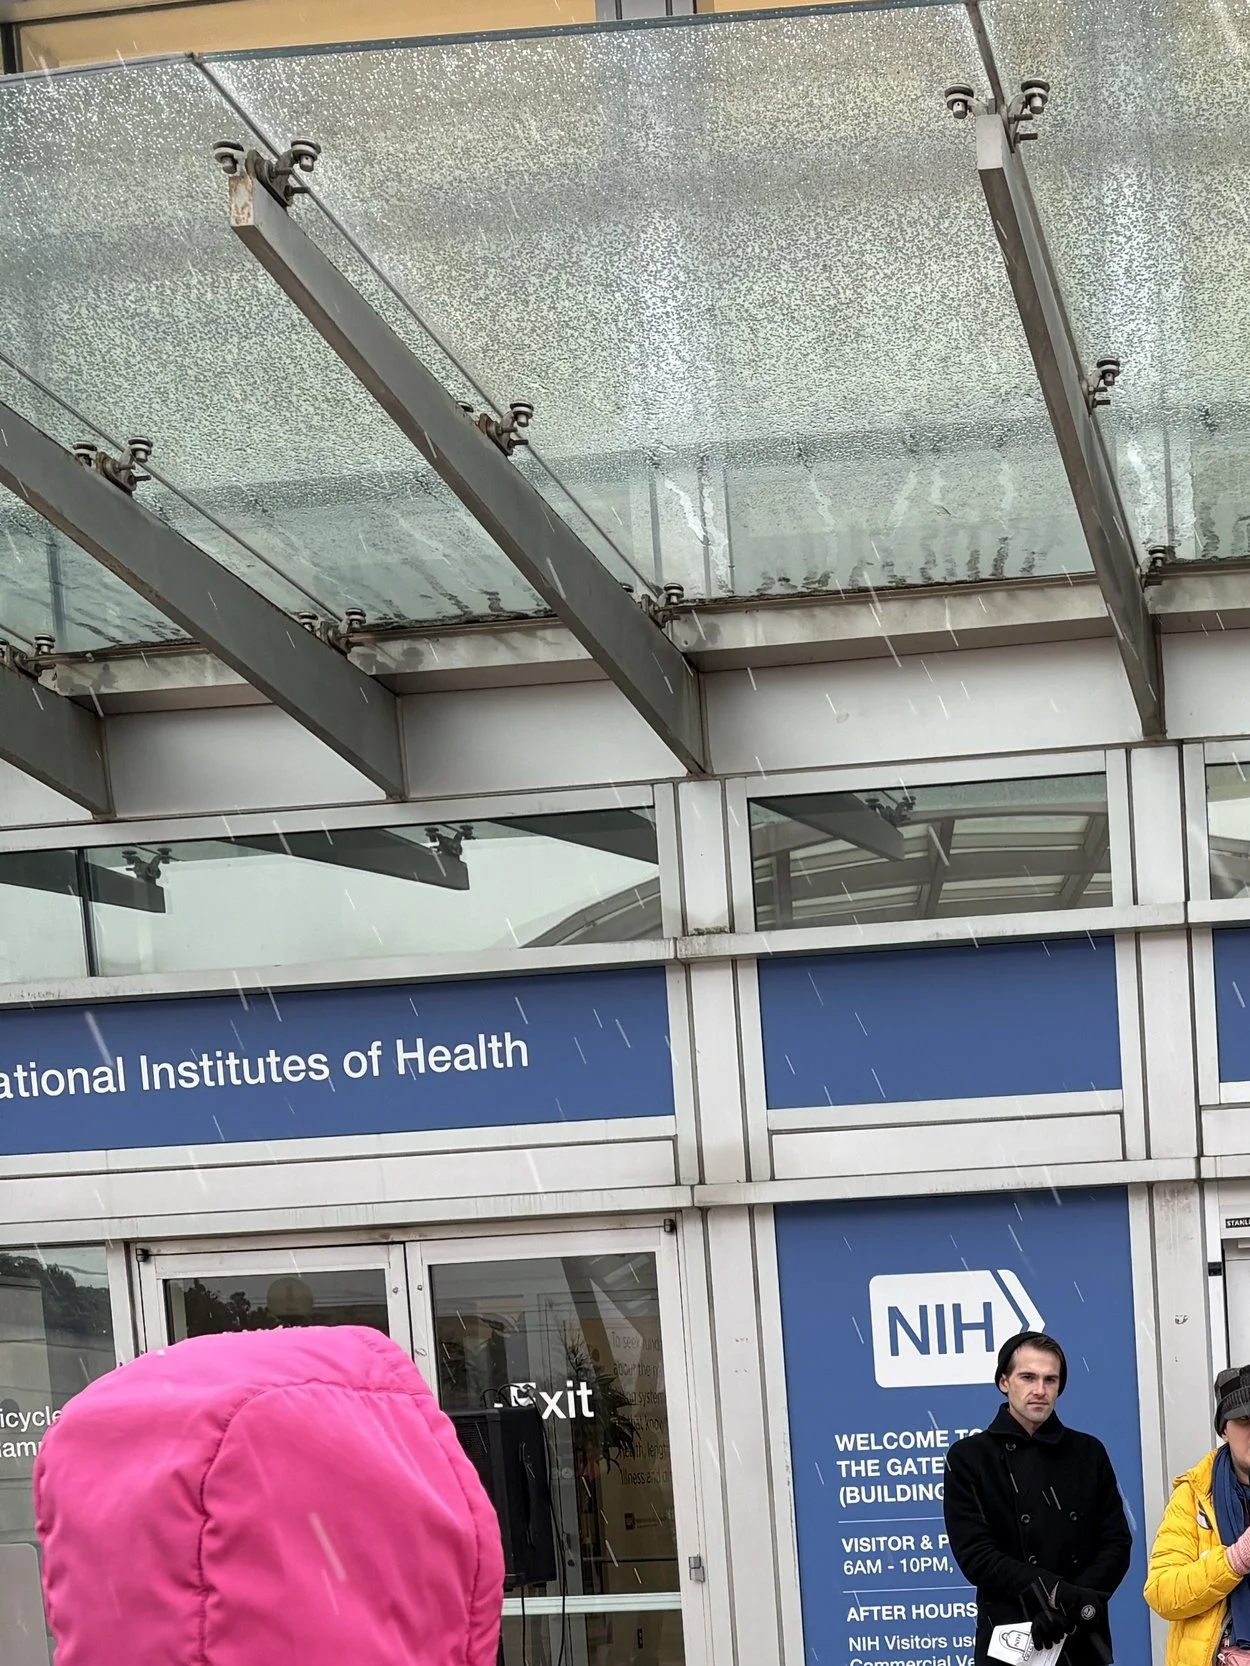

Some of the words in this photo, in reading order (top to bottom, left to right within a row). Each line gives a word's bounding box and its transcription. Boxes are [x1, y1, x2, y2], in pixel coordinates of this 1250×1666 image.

[139, 1048, 330, 1091] Institutes
[343, 1040, 382, 1080] of
[395, 1032, 529, 1075] Health
[887, 1301, 995, 1357] NIH
[835, 1430, 949, 1452] WELCOME
[836, 1459, 880, 1477] THE
[841, 1535, 915, 1553] VISITOR
[920, 1535, 933, 1550] &
[844, 1559, 882, 1575] 6AM
[900, 1557, 953, 1573] 10PM,
[847, 1605, 906, 1622] AFTER
[911, 1602, 978, 1620] HOURS
[849, 1636, 879, 1652] NIH
[884, 1634, 947, 1650] Visitors
